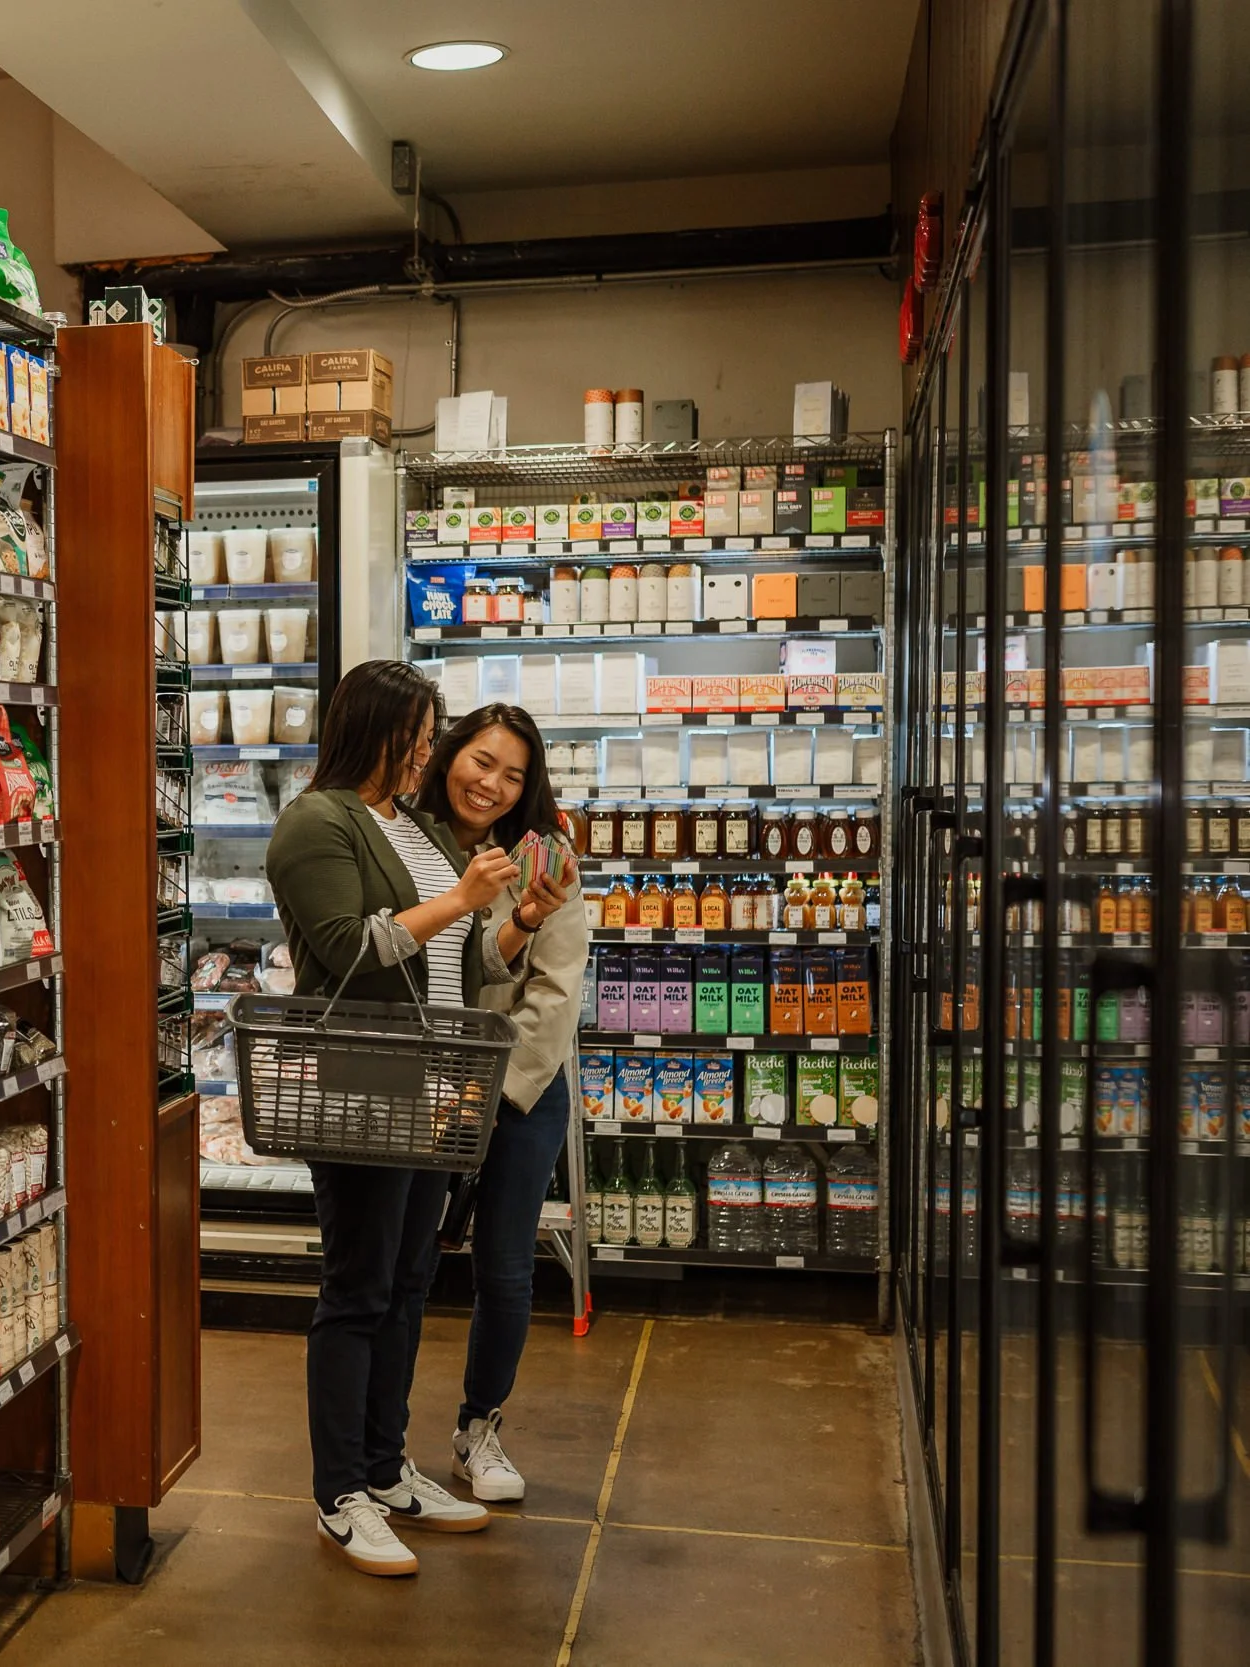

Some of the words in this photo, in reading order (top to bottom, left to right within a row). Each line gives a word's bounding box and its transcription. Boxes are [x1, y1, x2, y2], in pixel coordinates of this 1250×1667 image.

[320, 357, 359, 367] CALIFIA
[254, 364, 292, 374] CALIFIA
[426, 591, 450, 601] HAWT
[422, 600, 456, 612] CHOCO-
[431, 610, 453, 620] LATE
[647, 678, 690, 693] FLOWERHEAD
[694, 678, 737, 693] FLOWERHEAD
[740, 676, 784, 693] FLOWERHEAD
[790, 675, 834, 692] FLOWERHEAD
[838, 676, 881, 693] FLOWERHEAD
[707, 687, 724, 695] TEA
[753, 686, 770, 694] TEA
[802, 686, 820, 694] TEA
[850, 686, 867, 694] TEA
[656, 822, 675, 830] HONEY
[604, 966, 623, 974] Willa's
[604, 985, 624, 993] OAT
[777, 988, 797, 996] OAT
[811, 988, 830, 996] OAT
[747, 1056, 784, 1070] Pacific
[798, 1056, 836, 1069] Pacific
[841, 1056, 879, 1070] Pacific
[581, 1065, 611, 1076] Almond
[618, 1067, 652, 1078] Almond
[656, 1069, 690, 1080] Almond
[697, 1070, 731, 1081] Almond
